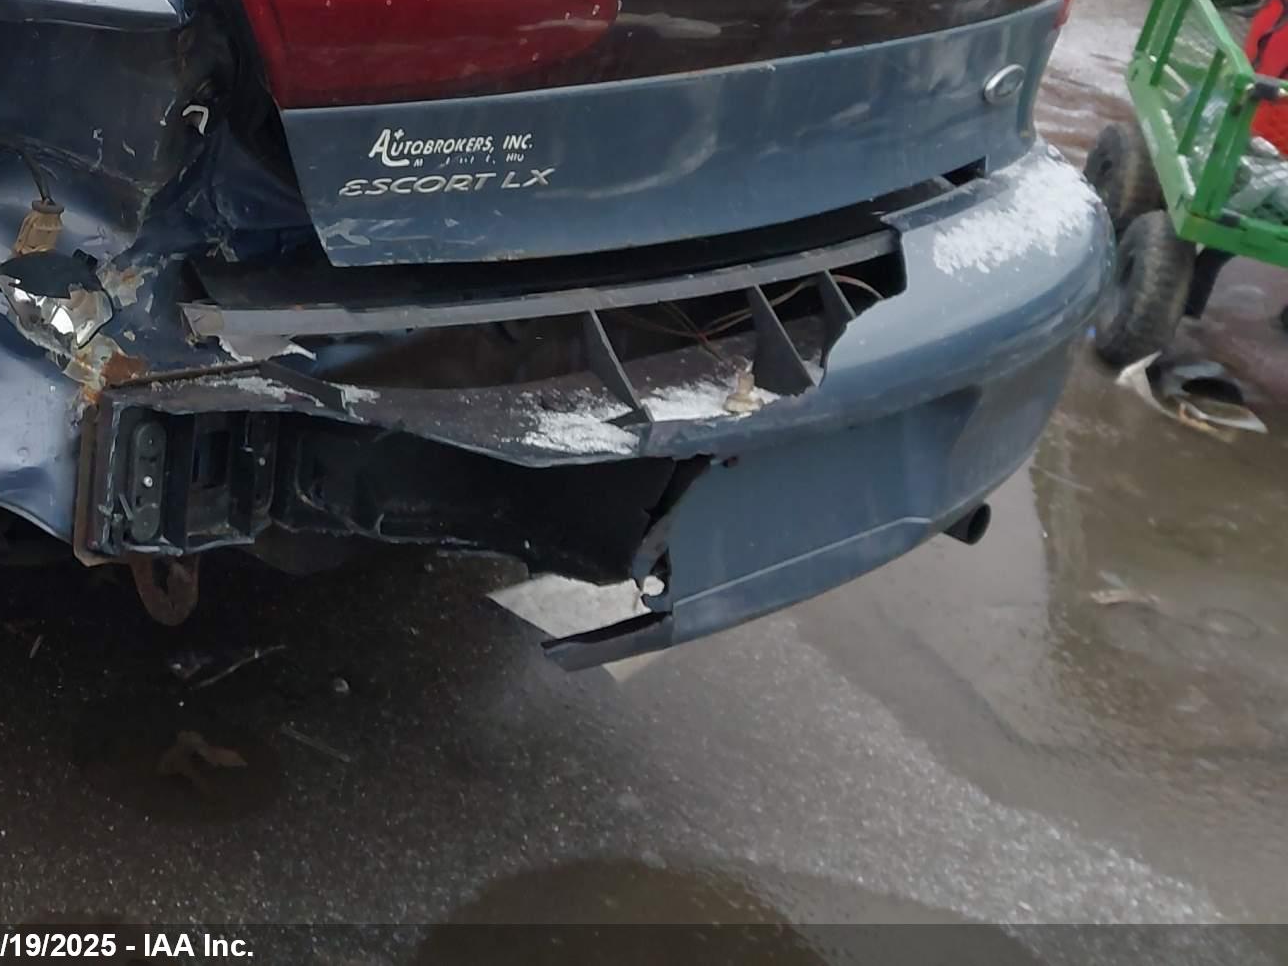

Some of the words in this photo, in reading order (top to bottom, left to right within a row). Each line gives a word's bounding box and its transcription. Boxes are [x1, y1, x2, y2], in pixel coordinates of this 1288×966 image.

[503, 134, 533, 151] INC.
[339, 173, 497, 197] ESCORT
[501, 168, 556, 189] LX
